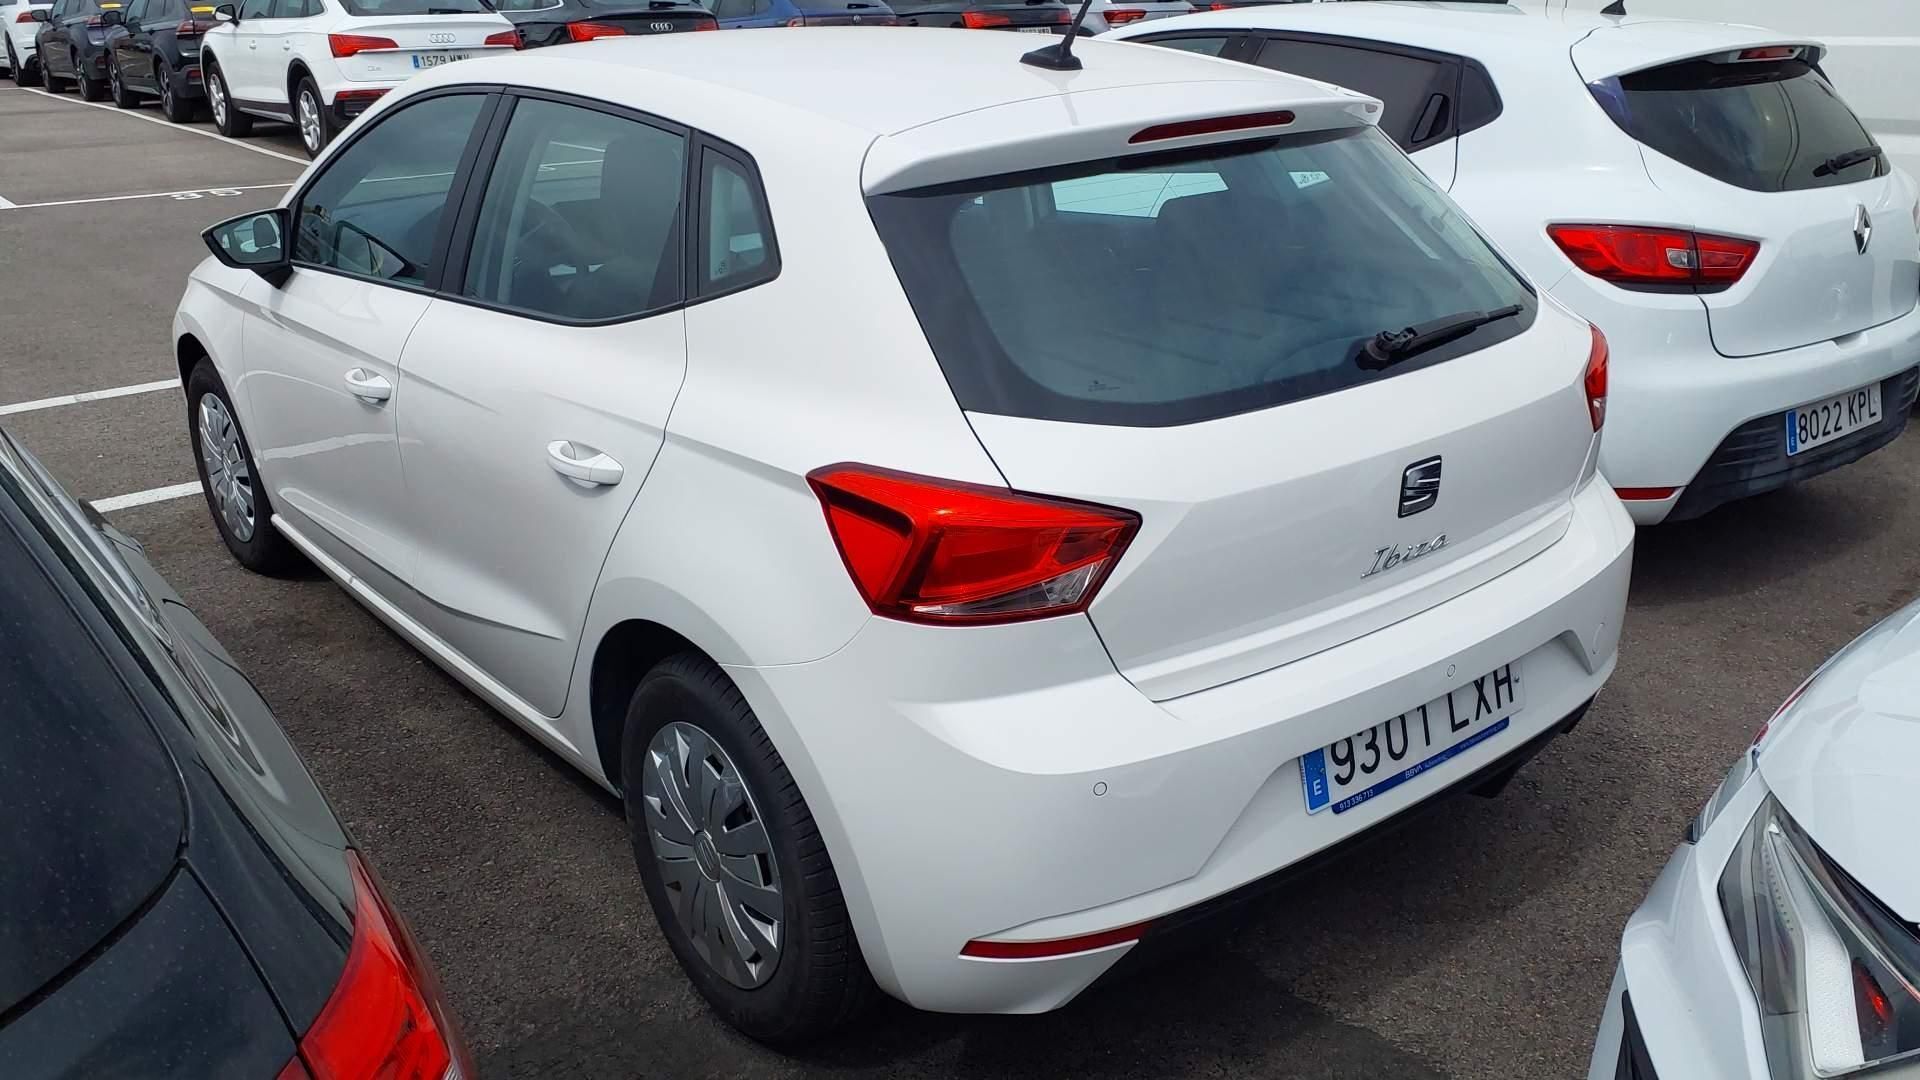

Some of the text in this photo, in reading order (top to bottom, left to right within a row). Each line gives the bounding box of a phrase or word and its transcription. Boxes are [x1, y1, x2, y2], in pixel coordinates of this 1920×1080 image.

[421, 55, 446, 67] 1579
[1799, 388, 1877, 444] 8022 KPL
[1360, 534, 1449, 579] Ibiza
[1330, 664, 1514, 786] 9301 LXH
[1313, 779, 1322, 796] E
[1405, 765, 1423, 779] BBVA
